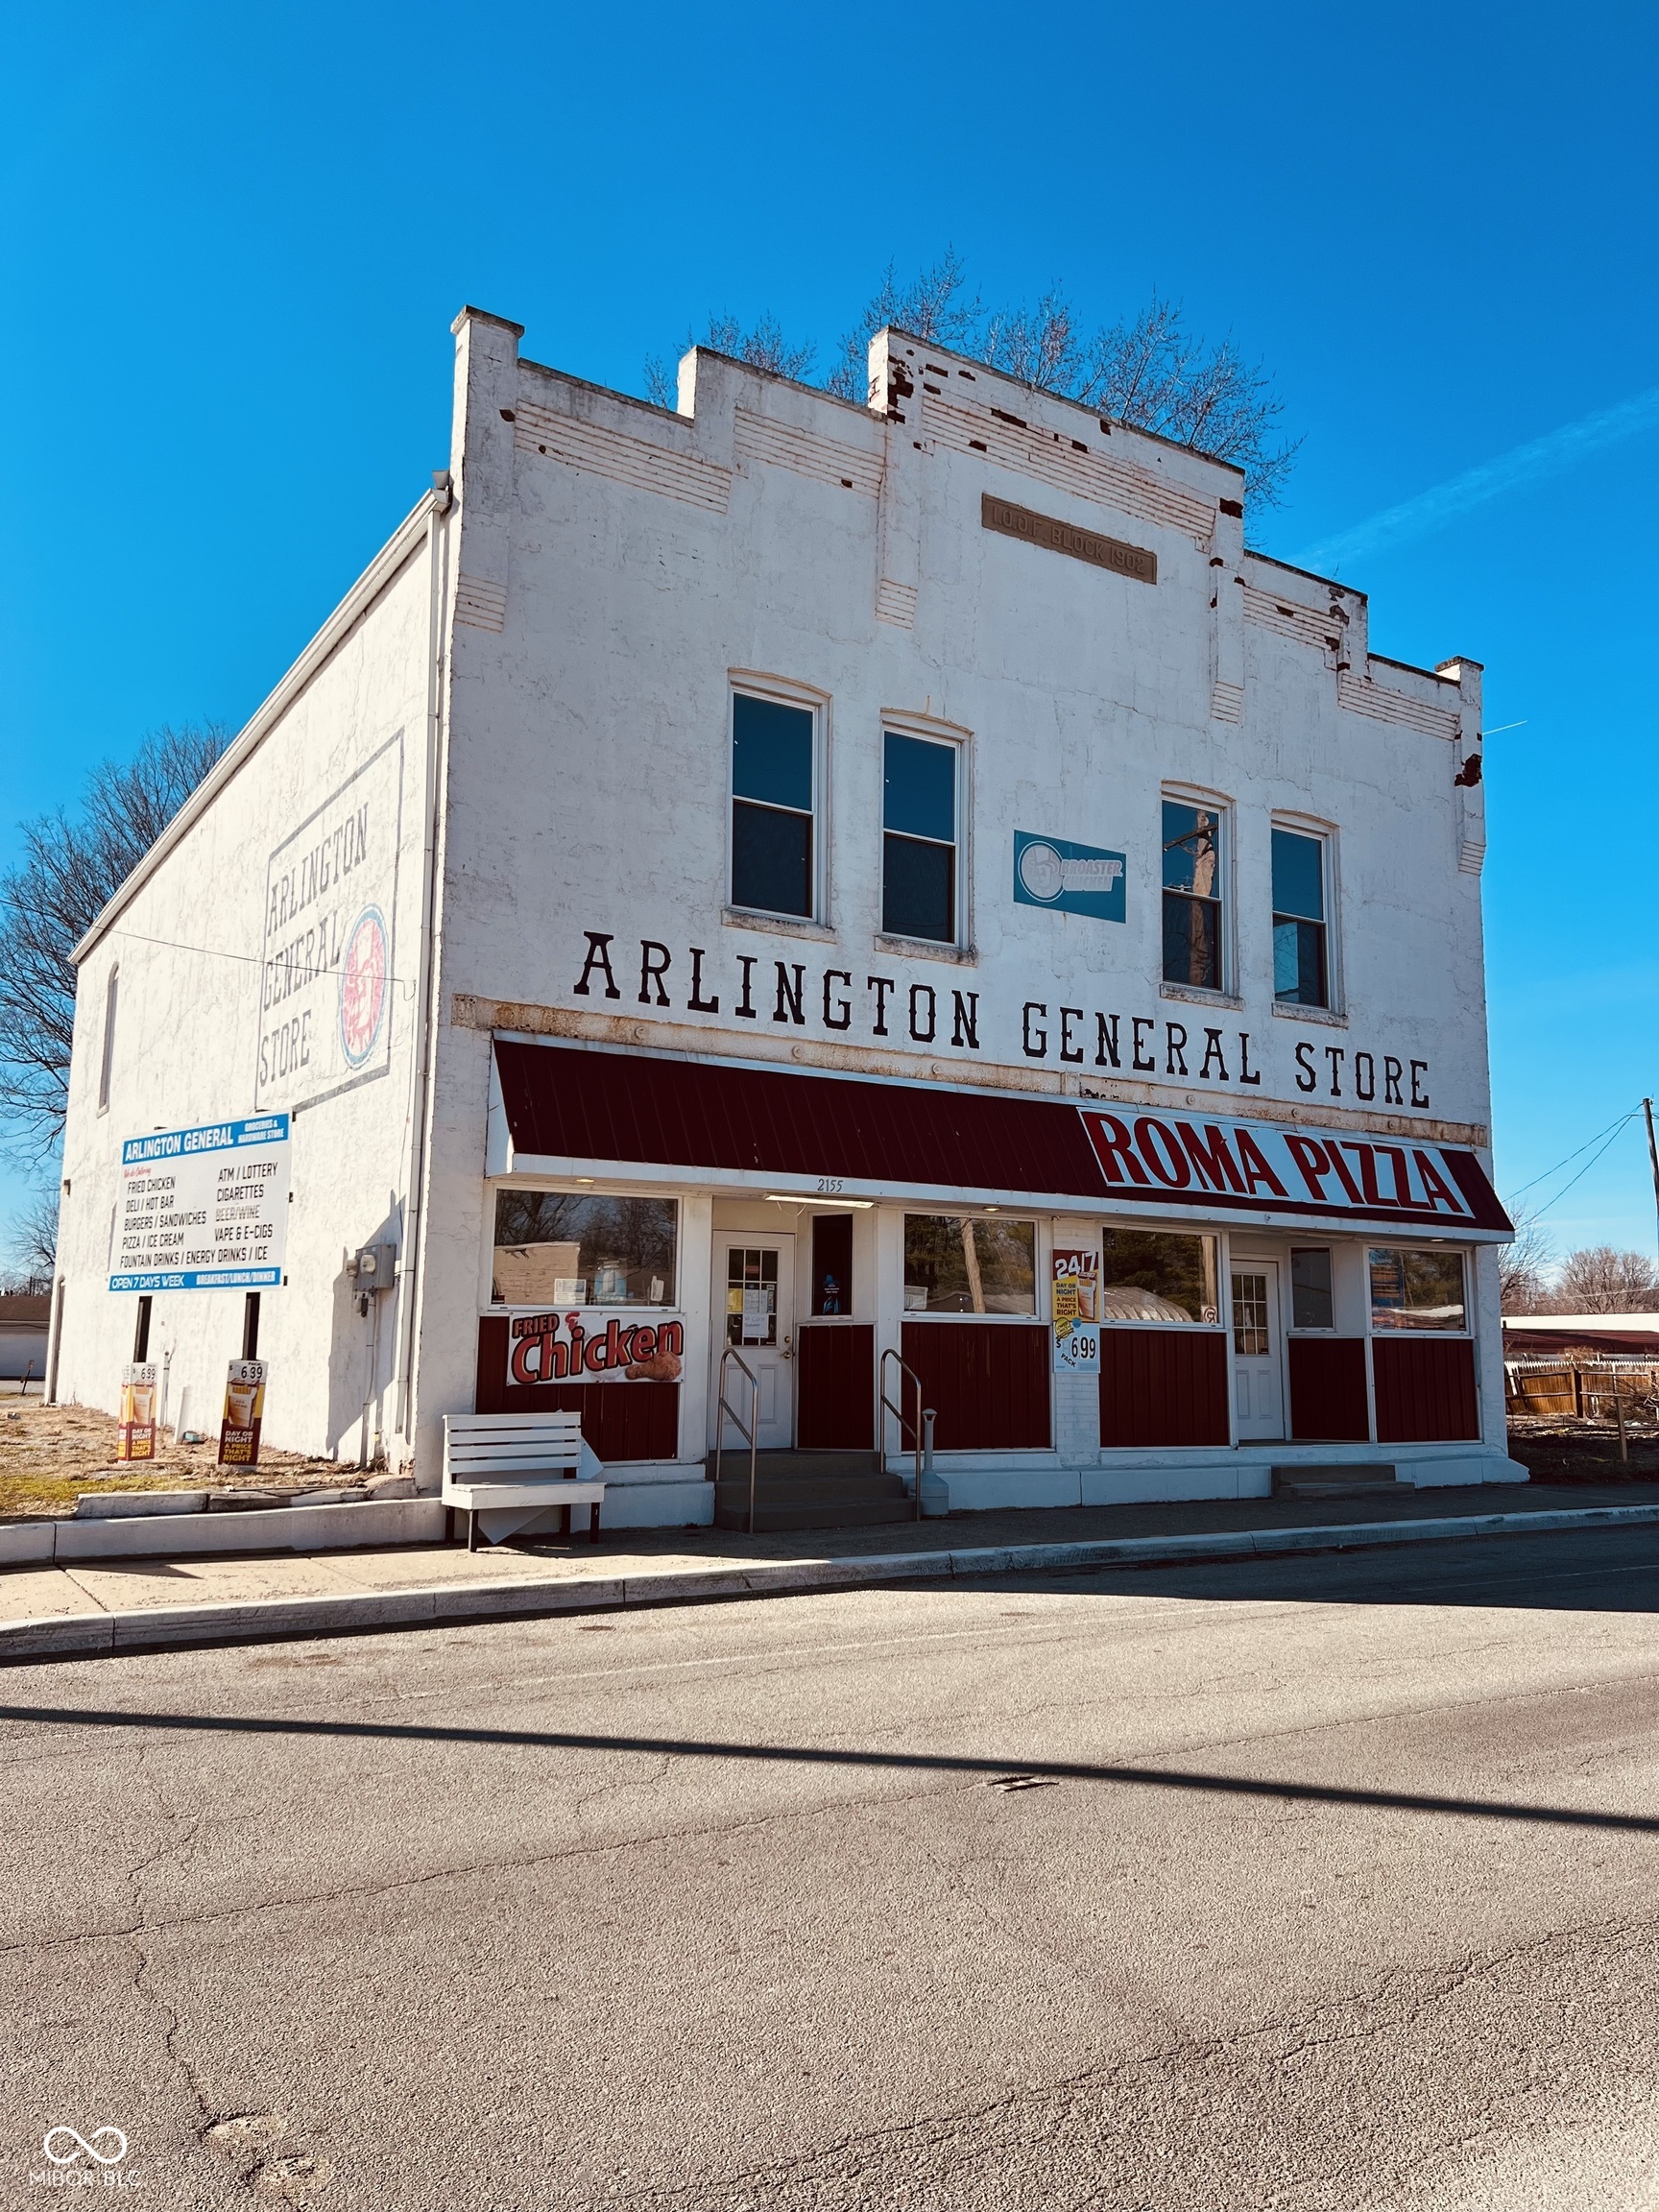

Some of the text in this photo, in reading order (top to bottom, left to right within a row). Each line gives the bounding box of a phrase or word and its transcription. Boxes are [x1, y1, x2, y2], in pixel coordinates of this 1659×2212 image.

[1051, 528, 1104, 561] BLOCK
[1111, 548, 1145, 575] 1902
[268, 802, 369, 938] ARLINGTON
[1062, 859, 1121, 876] BROASTER
[263, 910, 341, 1012] GENERAL
[573, 930, 1430, 1109] ARLINGTON GENERAL STORE
[259, 1009, 312, 1088] STORE
[125, 1125, 234, 1162] ARLINGTON GENERAL
[267, 1128, 284, 1140] STORE
[218, 1167, 234, 1183] ATM
[242, 1162, 278, 1179] LOTTERY
[1082, 1111, 1466, 1214] ROMA PIZZA
[128, 1176, 176, 1194] FRIED CHICKEN
[217, 1184, 264, 1202] CIGARETTES
[817, 1178, 844, 1192] 2155
[126, 1198, 140, 1213] DELI
[146, 1196, 159, 1211] HOT
[160, 1195, 175, 1210] BAR
[124, 1215, 154, 1231] BURGERS
[159, 1211, 206, 1228] SANDWICHES
[123, 1236, 140, 1250] PIZZA
[147, 1235, 157, 1248] ICE
[159, 1233, 184, 1247] CREAM
[215, 1224, 273, 1242] VAPE & E-CIGS
[120, 1254, 152, 1268] FOUNTAIN
[154, 1252, 179, 1266] DRINKS
[186, 1249, 215, 1264] ENERGY
[218, 1247, 247, 1262] DRINKS
[254, 1245, 269, 1261] ICE
[1055, 1251, 1096, 1280] 24/7
[111, 1275, 185, 1289] OPEN 7 DAYS WEEK
[512, 1312, 560, 1338] FRIED
[512, 1319, 684, 1383] Chicken
[1061, 1354, 1076, 1367] PACK
